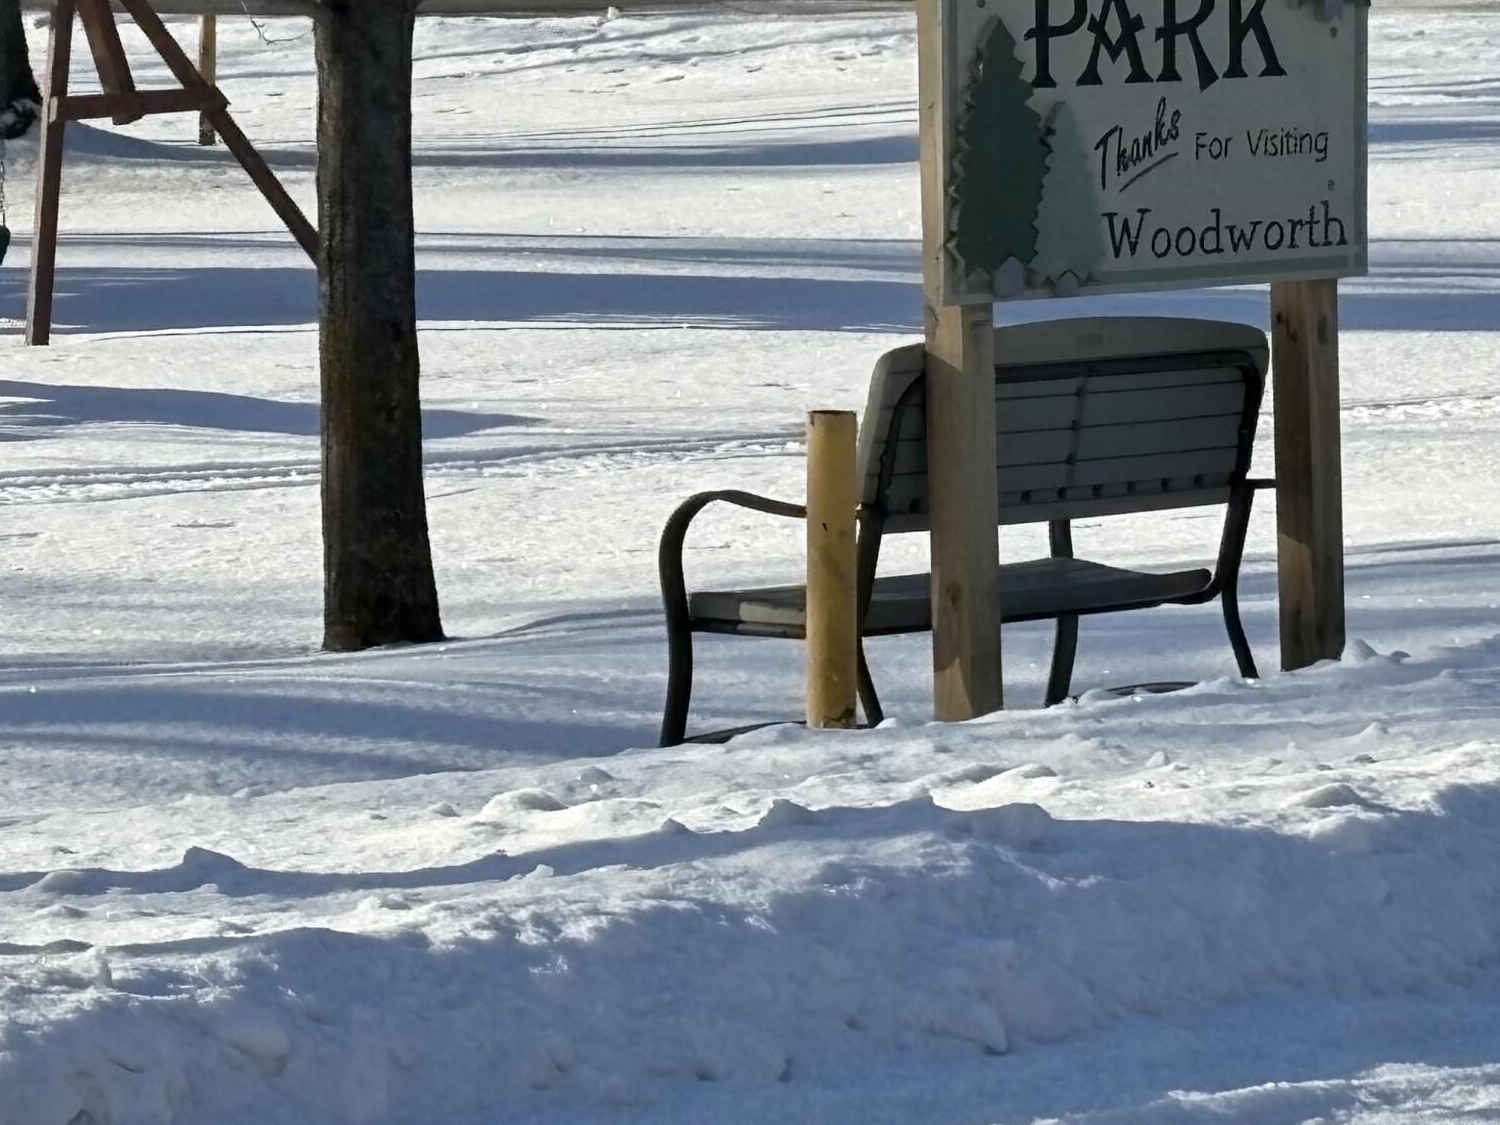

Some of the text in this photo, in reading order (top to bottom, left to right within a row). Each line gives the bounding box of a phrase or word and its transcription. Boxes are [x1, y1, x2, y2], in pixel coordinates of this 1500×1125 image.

[1094, 97, 1329, 191] Thanks For Visiting
[1101, 201, 1349, 259] Woodworth
